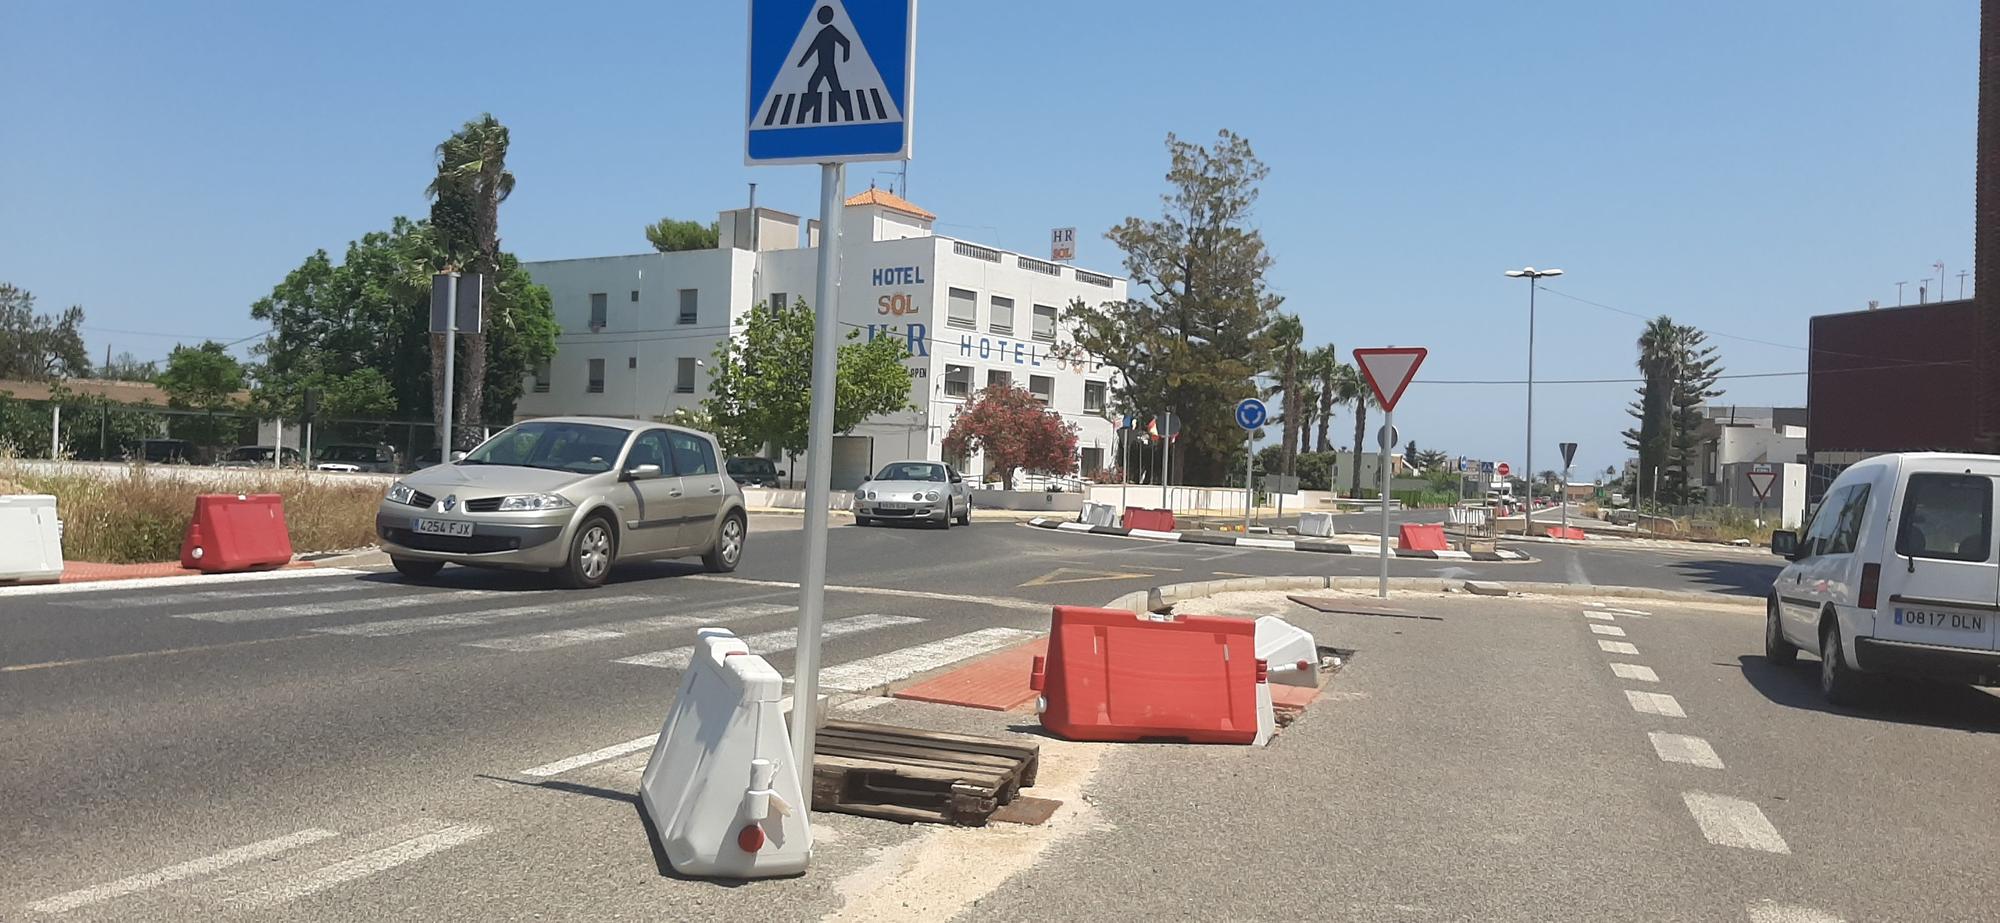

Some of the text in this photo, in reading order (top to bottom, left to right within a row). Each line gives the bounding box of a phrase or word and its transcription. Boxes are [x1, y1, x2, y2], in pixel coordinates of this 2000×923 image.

[1053, 248, 1072, 258] SOL
[873, 266, 925, 286] HOTEL
[878, 294, 919, 316] SOL
[960, 334, 1040, 366] HOTEL
[420, 520, 470, 535] 4254 FJX
[1906, 611, 1981, 630] 0817 DLN
